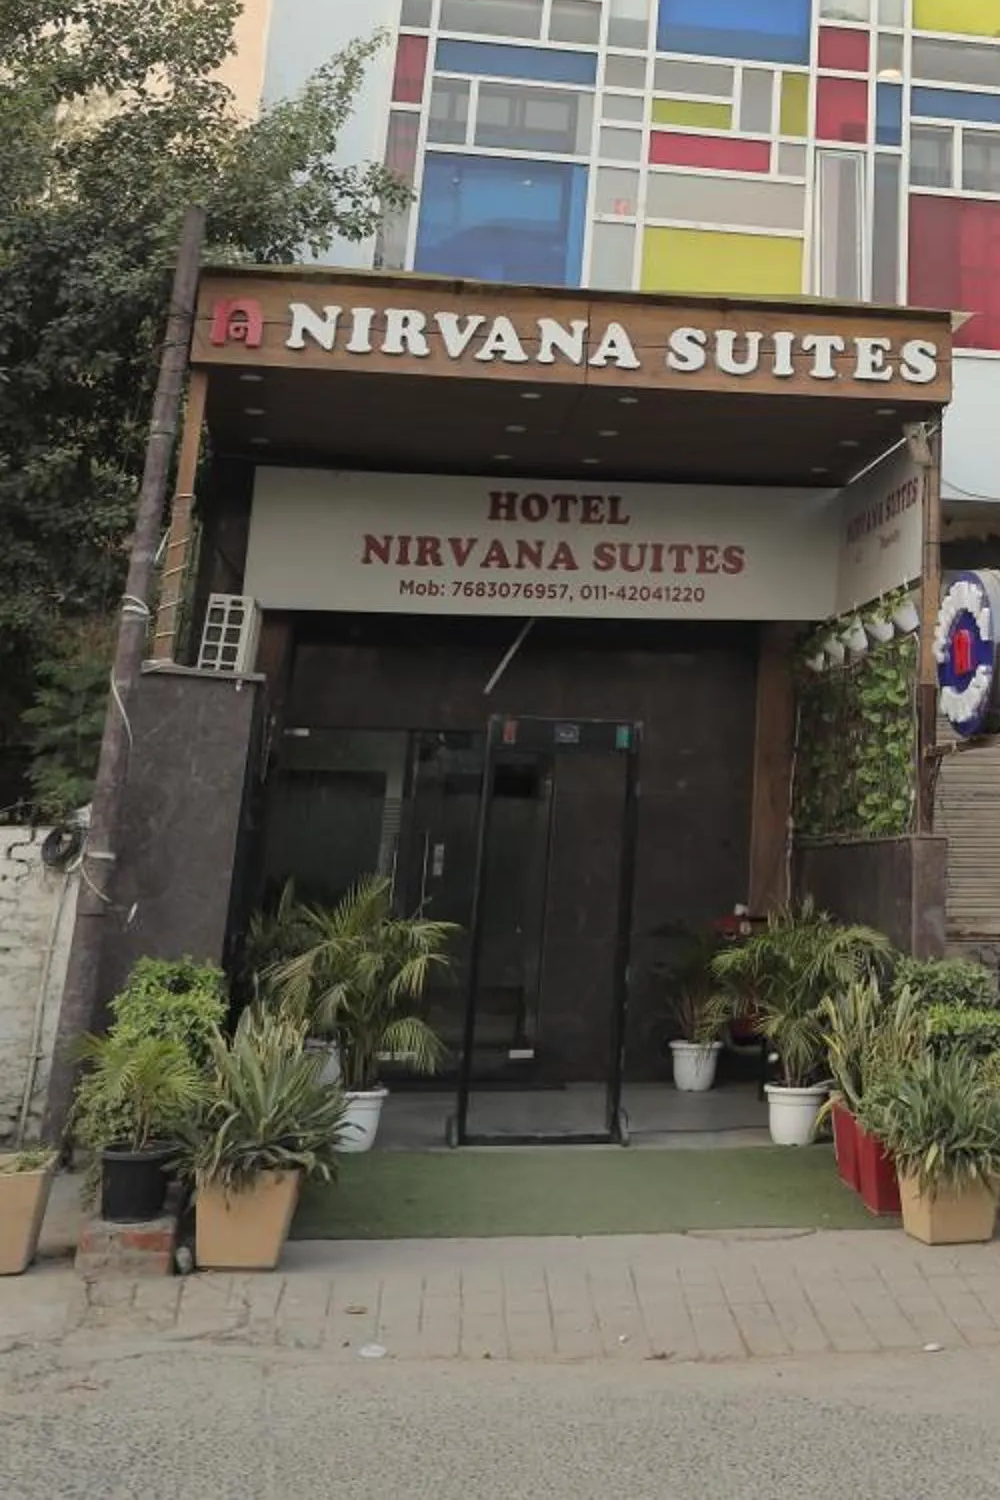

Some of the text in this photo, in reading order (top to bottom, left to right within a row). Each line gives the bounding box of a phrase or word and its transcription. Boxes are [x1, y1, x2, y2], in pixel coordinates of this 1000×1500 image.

[284, 302, 641, 370] NIRVANA
[665, 327, 940, 385] SUITES
[486, 491, 630, 525] HOTEL
[360, 534, 745, 575] NIRVANA SUITES
[399, 580, 705, 603] Mob: 7683076957, 011-42041220
